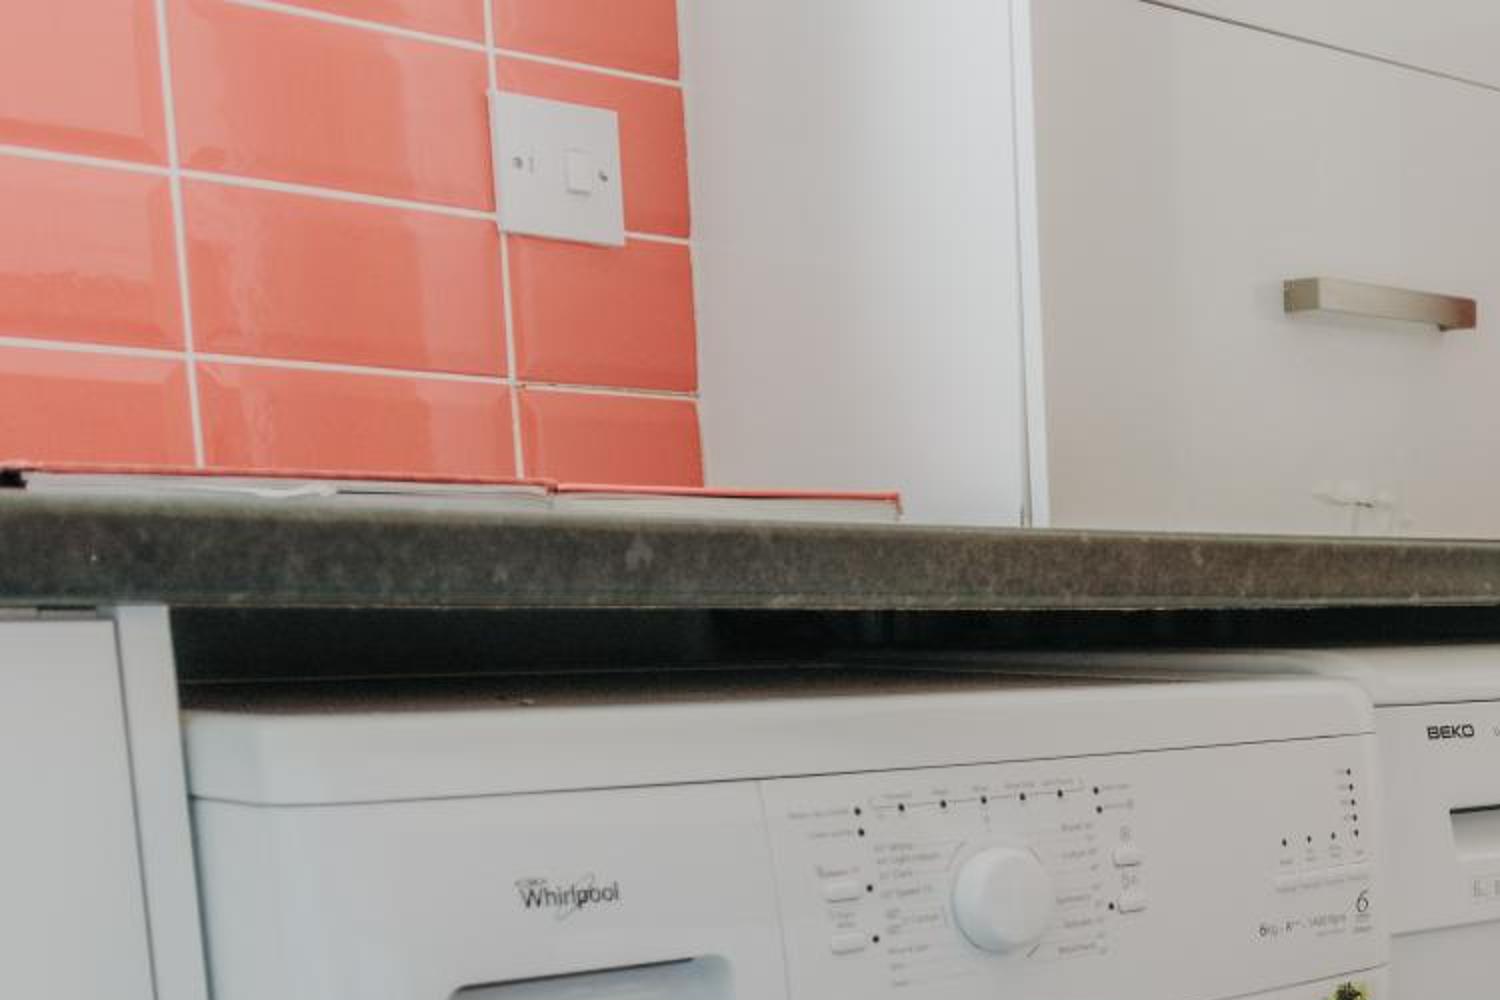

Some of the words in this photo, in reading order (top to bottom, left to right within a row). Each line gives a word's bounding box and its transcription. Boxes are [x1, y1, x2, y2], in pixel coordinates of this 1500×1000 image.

[1426, 723, 1475, 740] BEKO
[517, 879, 619, 909] Whirlpool
[1356, 888, 1369, 913] 6
